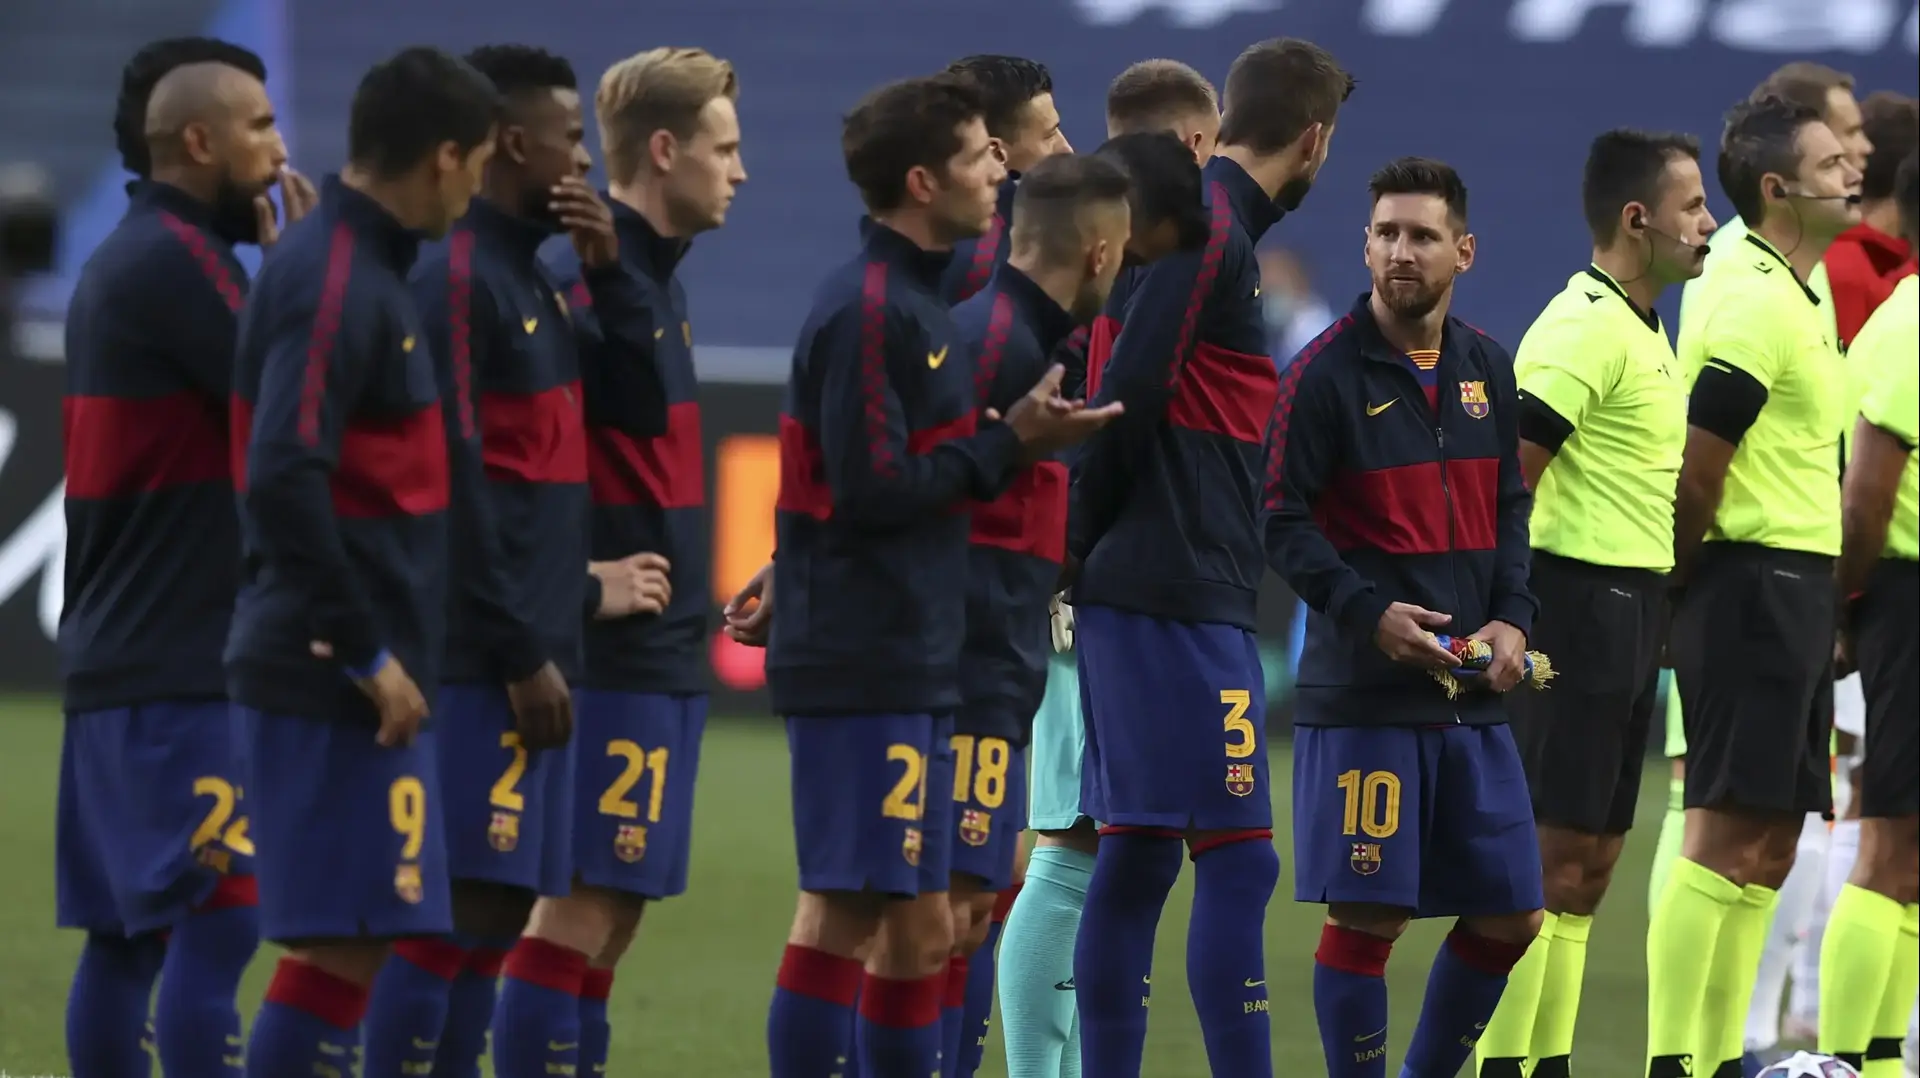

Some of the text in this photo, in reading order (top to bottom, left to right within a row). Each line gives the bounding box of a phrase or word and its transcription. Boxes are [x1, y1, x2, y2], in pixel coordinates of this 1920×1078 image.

[1220, 689, 1256, 758] 3
[598, 738, 669, 822] 21
[951, 734, 1009, 808] 18
[1337, 769, 1401, 838] 10
[389, 776, 424, 859] 9
